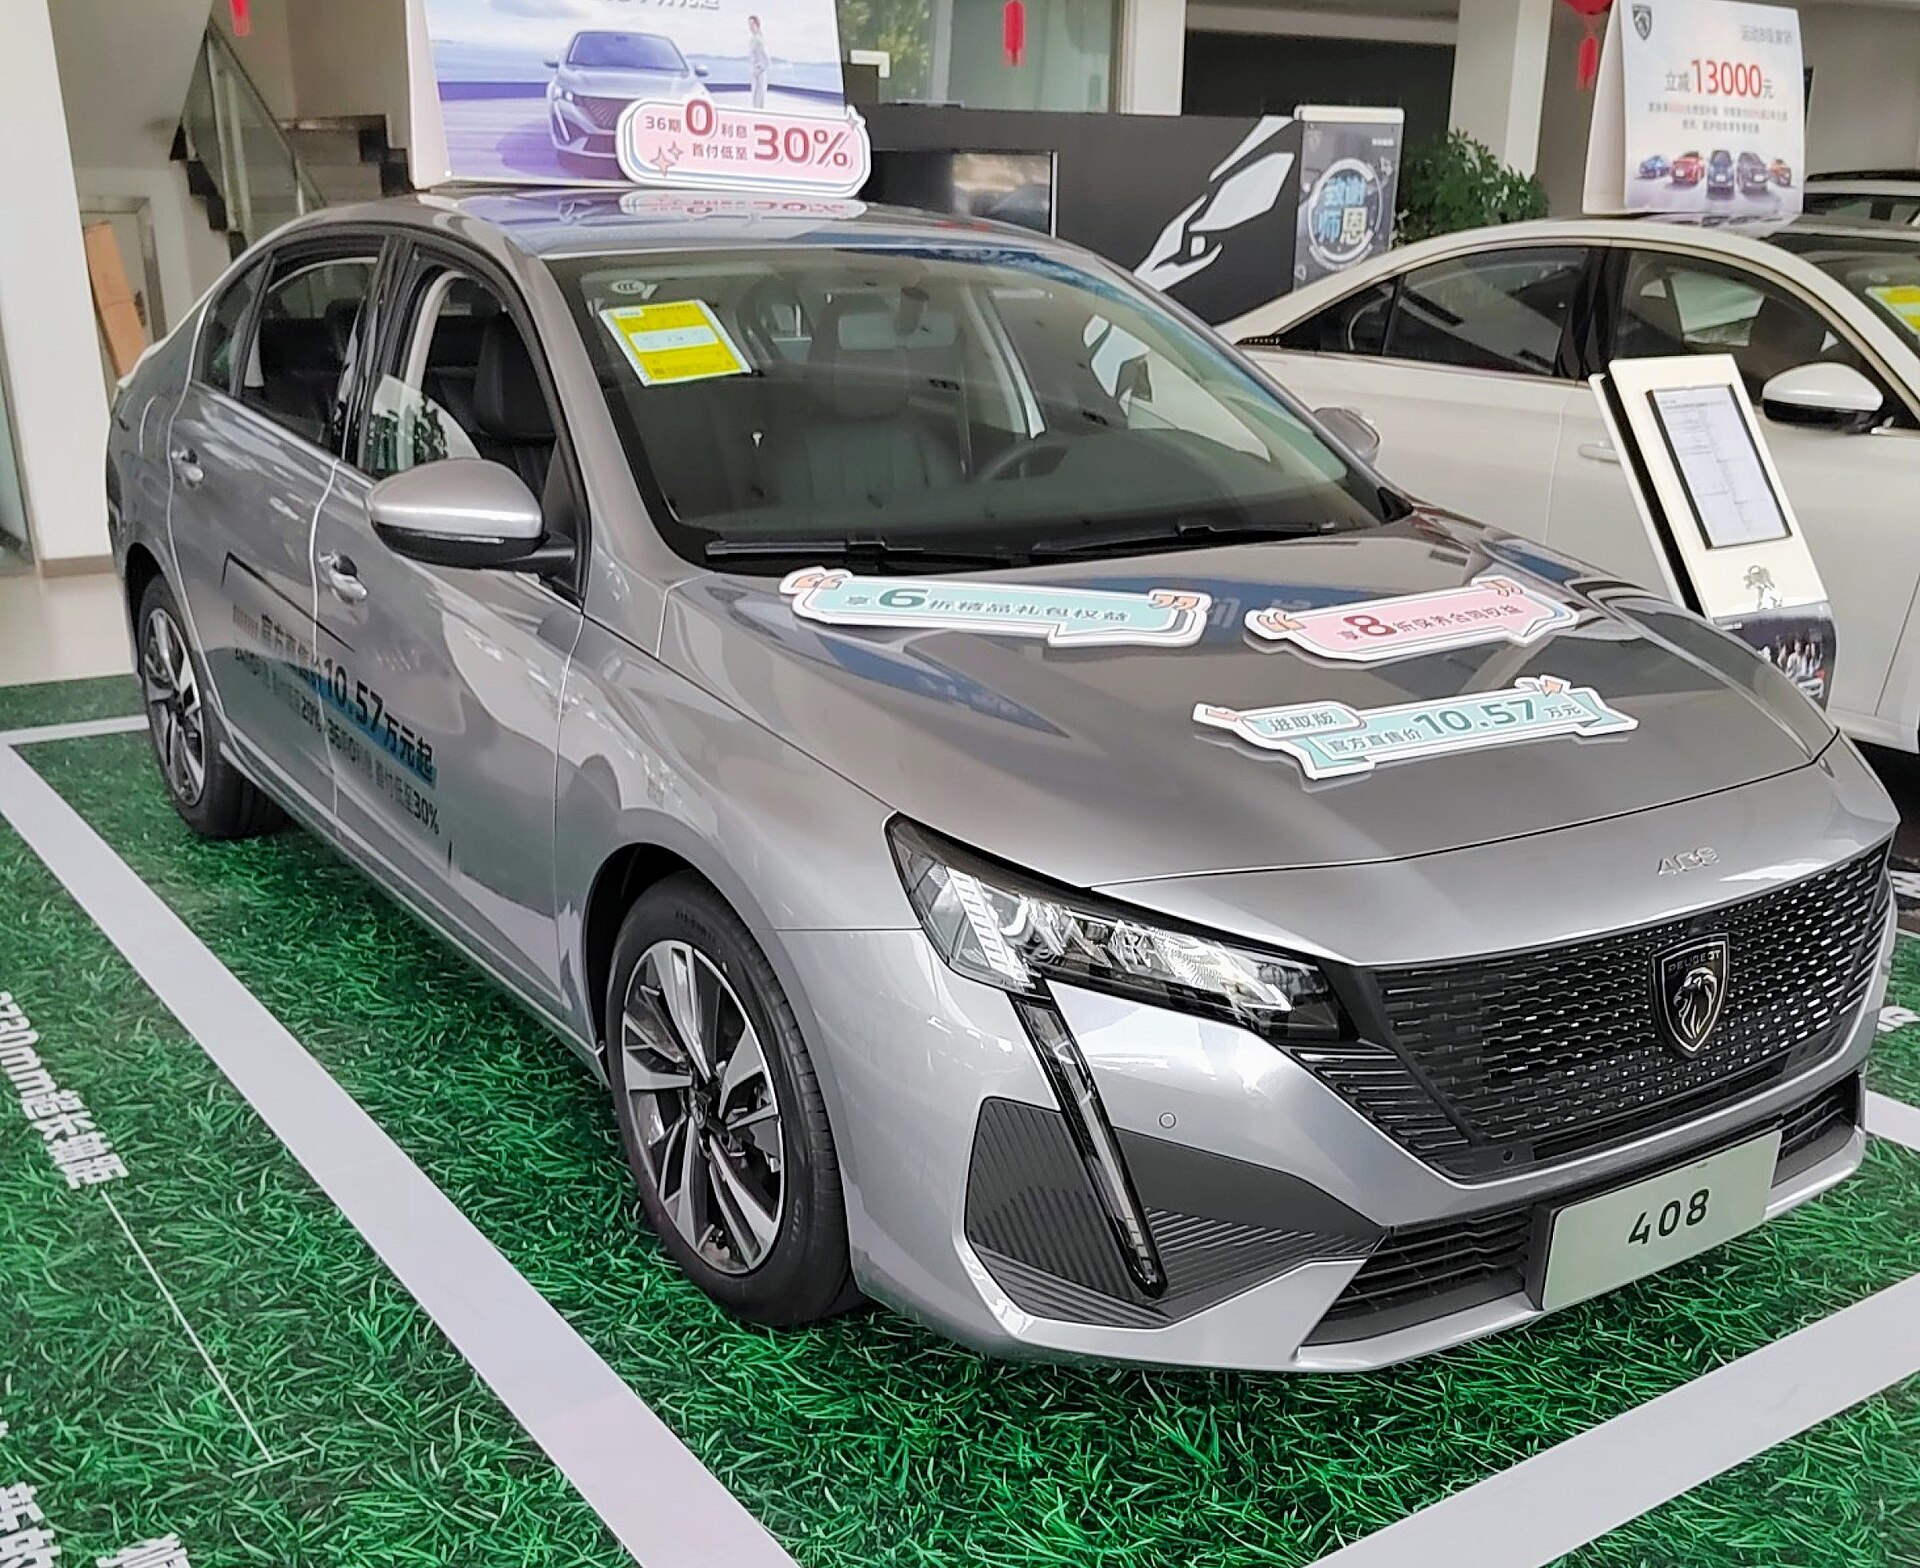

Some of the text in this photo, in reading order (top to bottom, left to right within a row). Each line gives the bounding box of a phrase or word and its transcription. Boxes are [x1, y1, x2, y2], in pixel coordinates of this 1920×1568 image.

[1665, 59, 1774, 99] 立减13000元
[1269, 712, 1338, 732] 进取版
[1658, 847, 1720, 876] 408
[1668, 950, 1721, 973] PEUGEOT
[1628, 1188, 1710, 1244] 408
